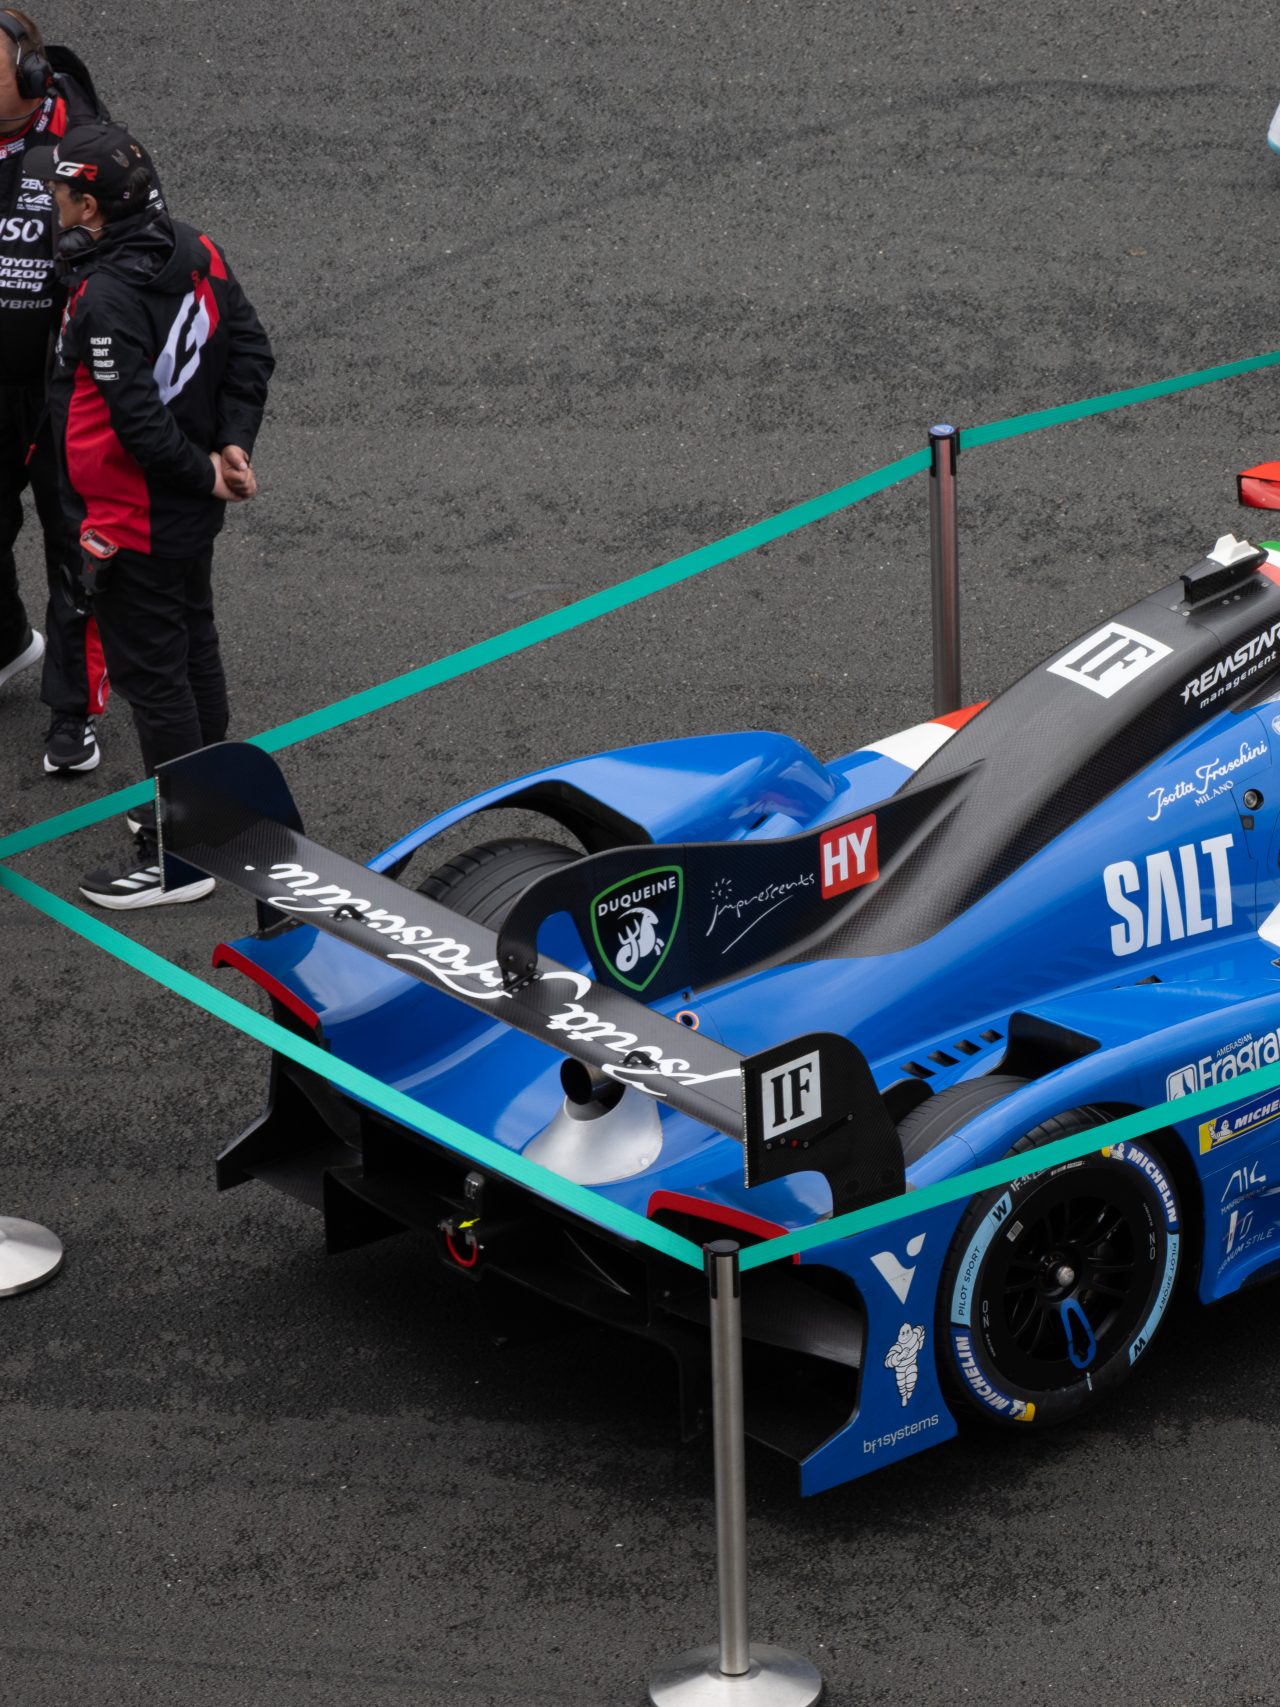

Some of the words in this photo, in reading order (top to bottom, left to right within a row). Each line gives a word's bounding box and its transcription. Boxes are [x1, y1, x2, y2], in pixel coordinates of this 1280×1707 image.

[0, 267, 48, 279] AZOO
[1200, 651, 1277, 709] management
[1147, 781, 1196, 822] Isotta
[1195, 740, 1268, 795] Fraschini
[1194, 780, 1235, 807] MILANO
[823, 825, 873, 887] HY
[597, 876, 677, 917] DUQUEINE
[1103, 833, 1234, 957] SALT
[1216, 1033, 1253, 1058] AMERASIAN
[770, 1061, 813, 1129] IF
[1127, 1148, 1178, 1223] MICHELIN
[964, 1246, 981, 1283] SPORT
[1169, 1242, 1177, 1273] PILOT
[959, 1283, 975, 1316] PILOT
[1159, 1275, 1173, 1311] SPORT
[956, 1336, 1010, 1411] MICHELIN
[863, 1414, 939, 1454] bf1systems
